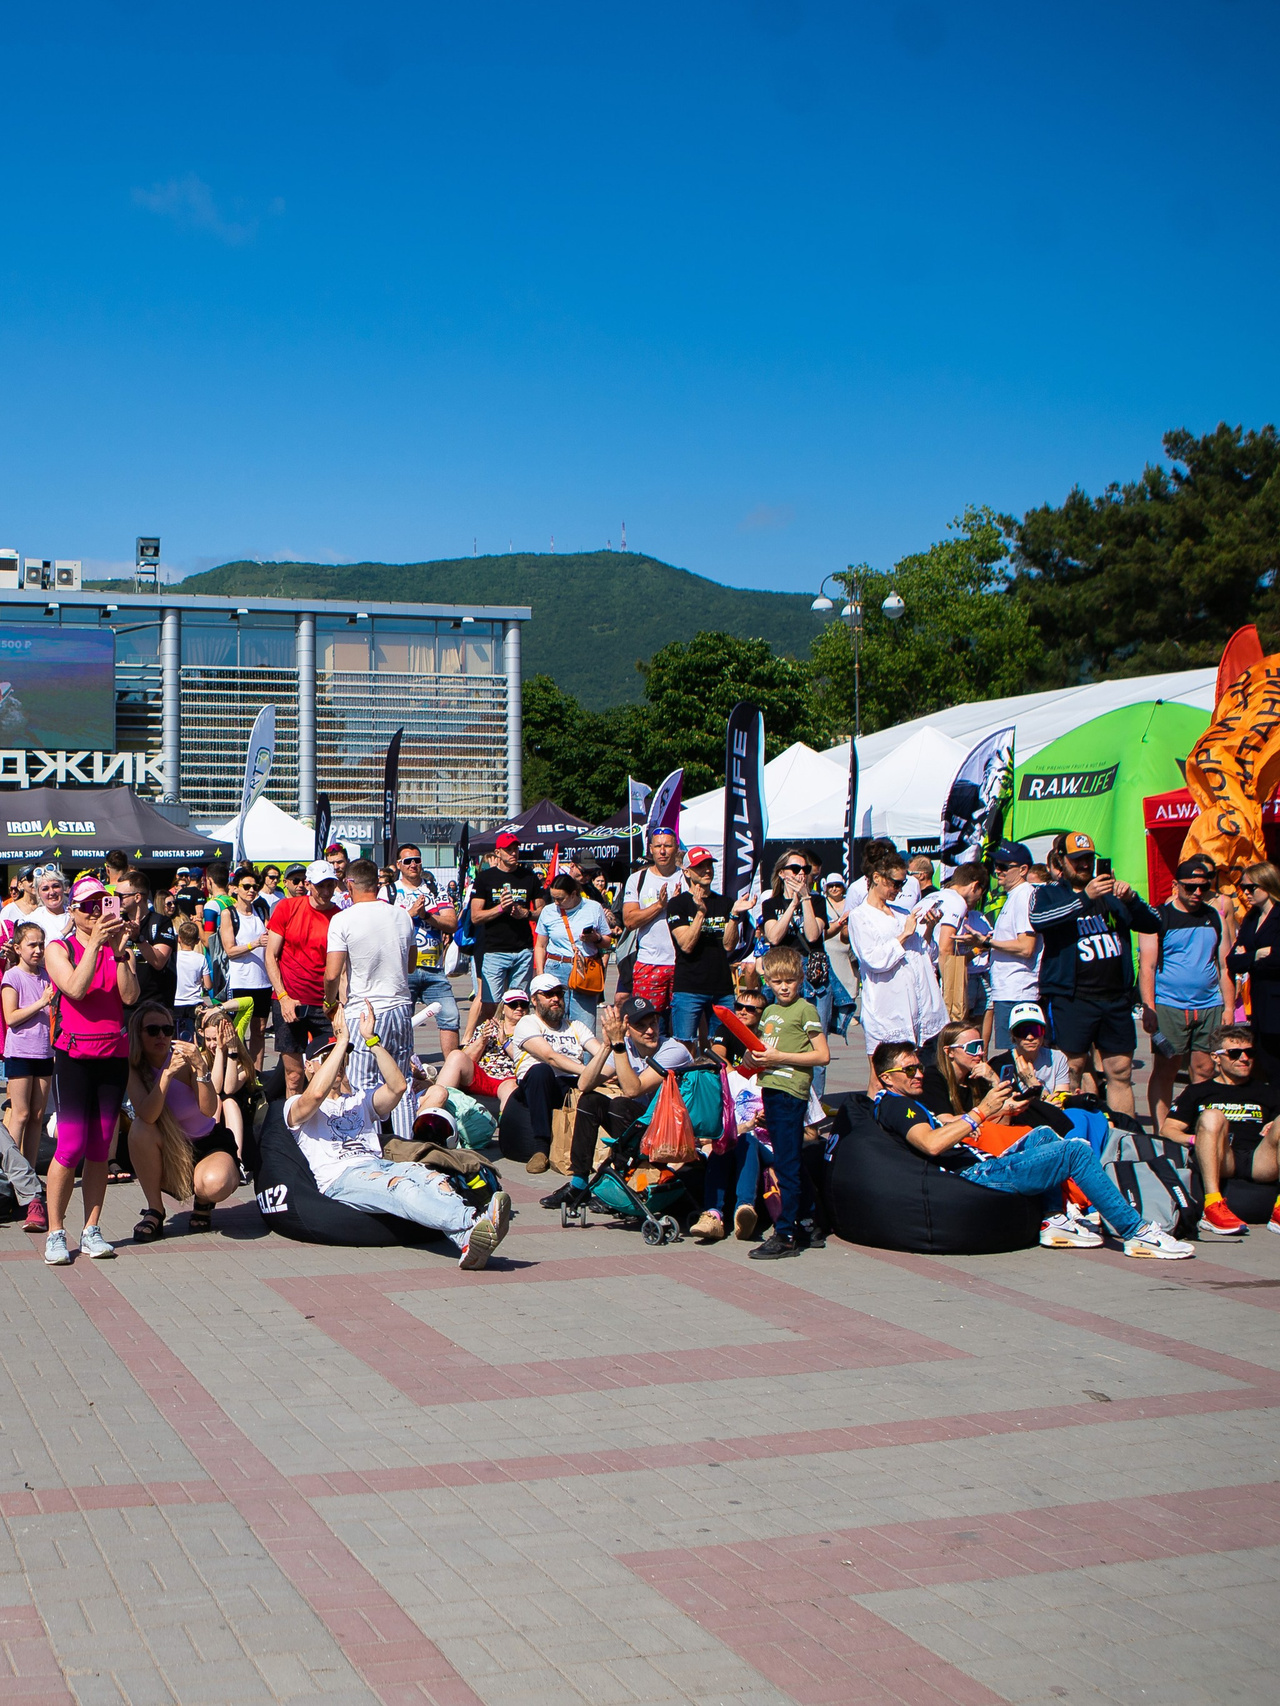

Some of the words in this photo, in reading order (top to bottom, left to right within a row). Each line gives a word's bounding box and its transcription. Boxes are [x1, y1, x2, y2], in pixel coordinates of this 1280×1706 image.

[1155, 803, 1202, 819] ALWA
[7, 821, 44, 833] IRON
[58, 821, 97, 834] STAR
[329, 824, 372, 839] РАВЫ
[24, 850, 44, 858] SHOP
[71, 849, 105, 858] IRONSTAR
[152, 850, 186, 858] IRONSTAR
[186, 850, 205, 858] SHOP
